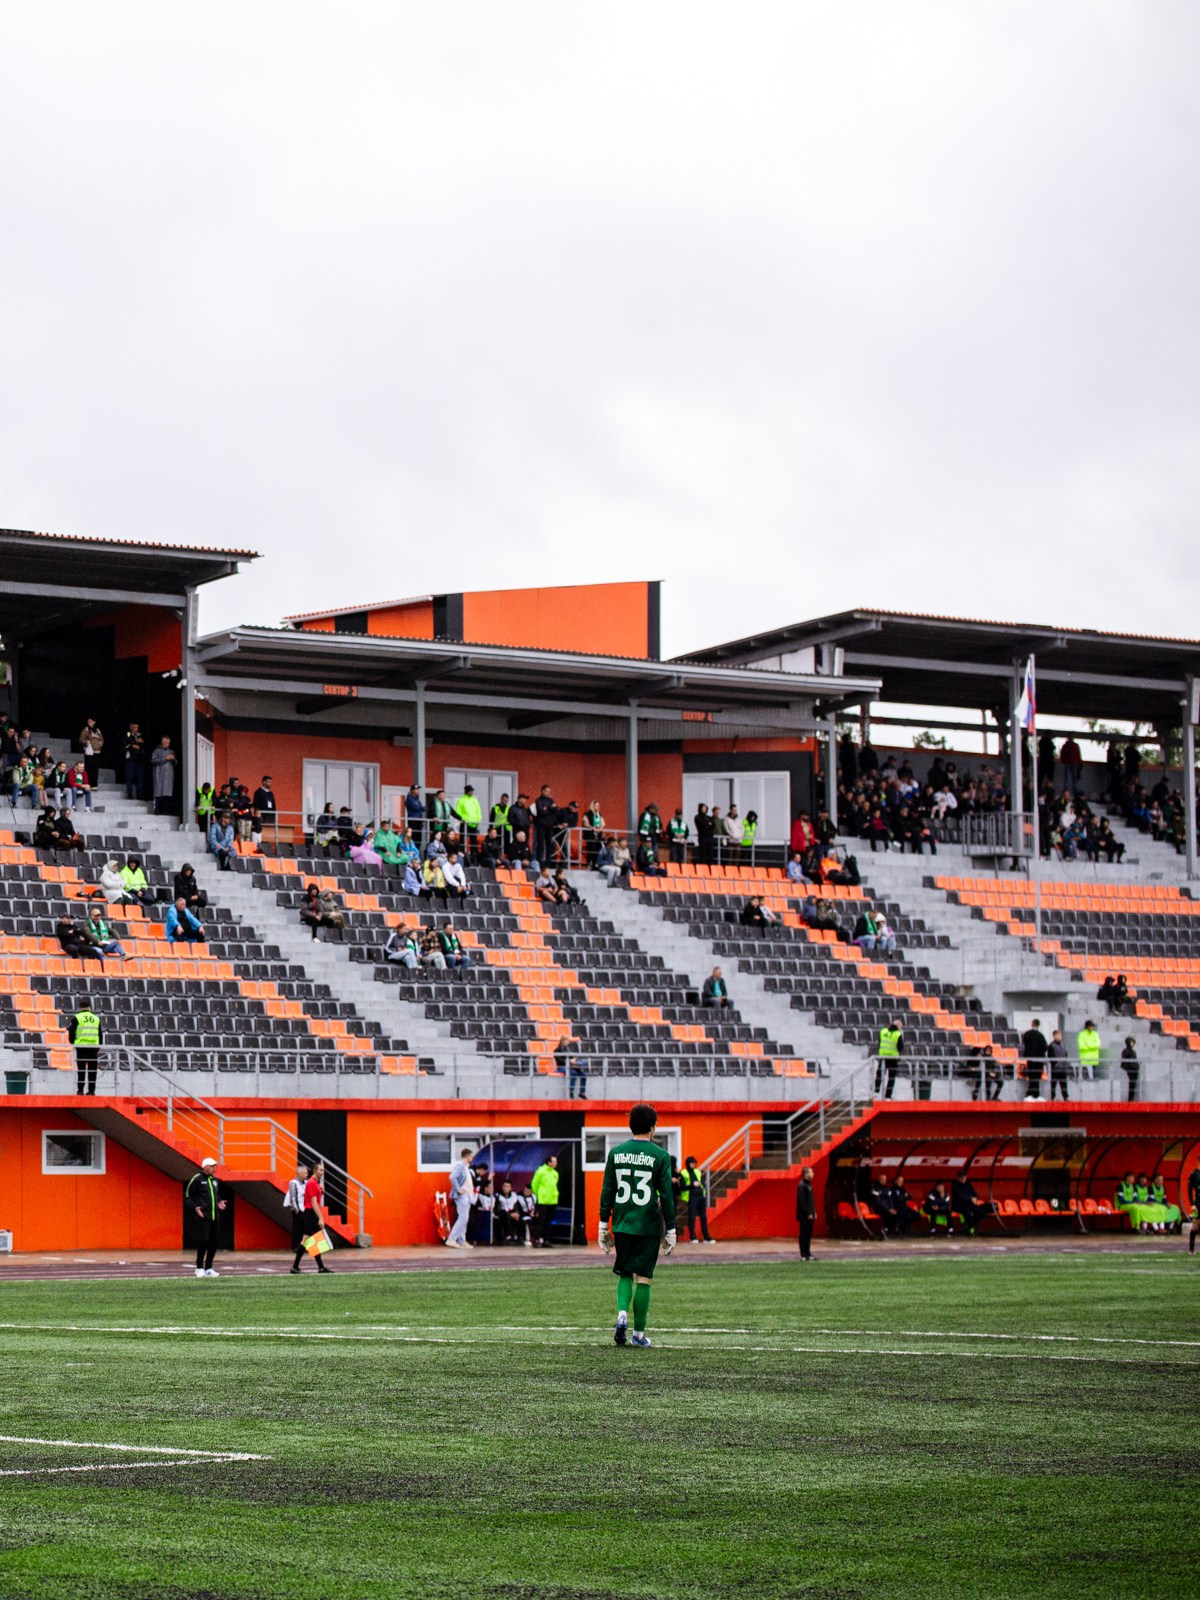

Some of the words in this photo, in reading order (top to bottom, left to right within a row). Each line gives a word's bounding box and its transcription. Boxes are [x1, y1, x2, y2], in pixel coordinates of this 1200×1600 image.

[83, 1015, 95, 1023] 36
[614, 1152, 656, 1168] ИЛЬЮШЁНОК
[615, 1168, 653, 1206] 53
